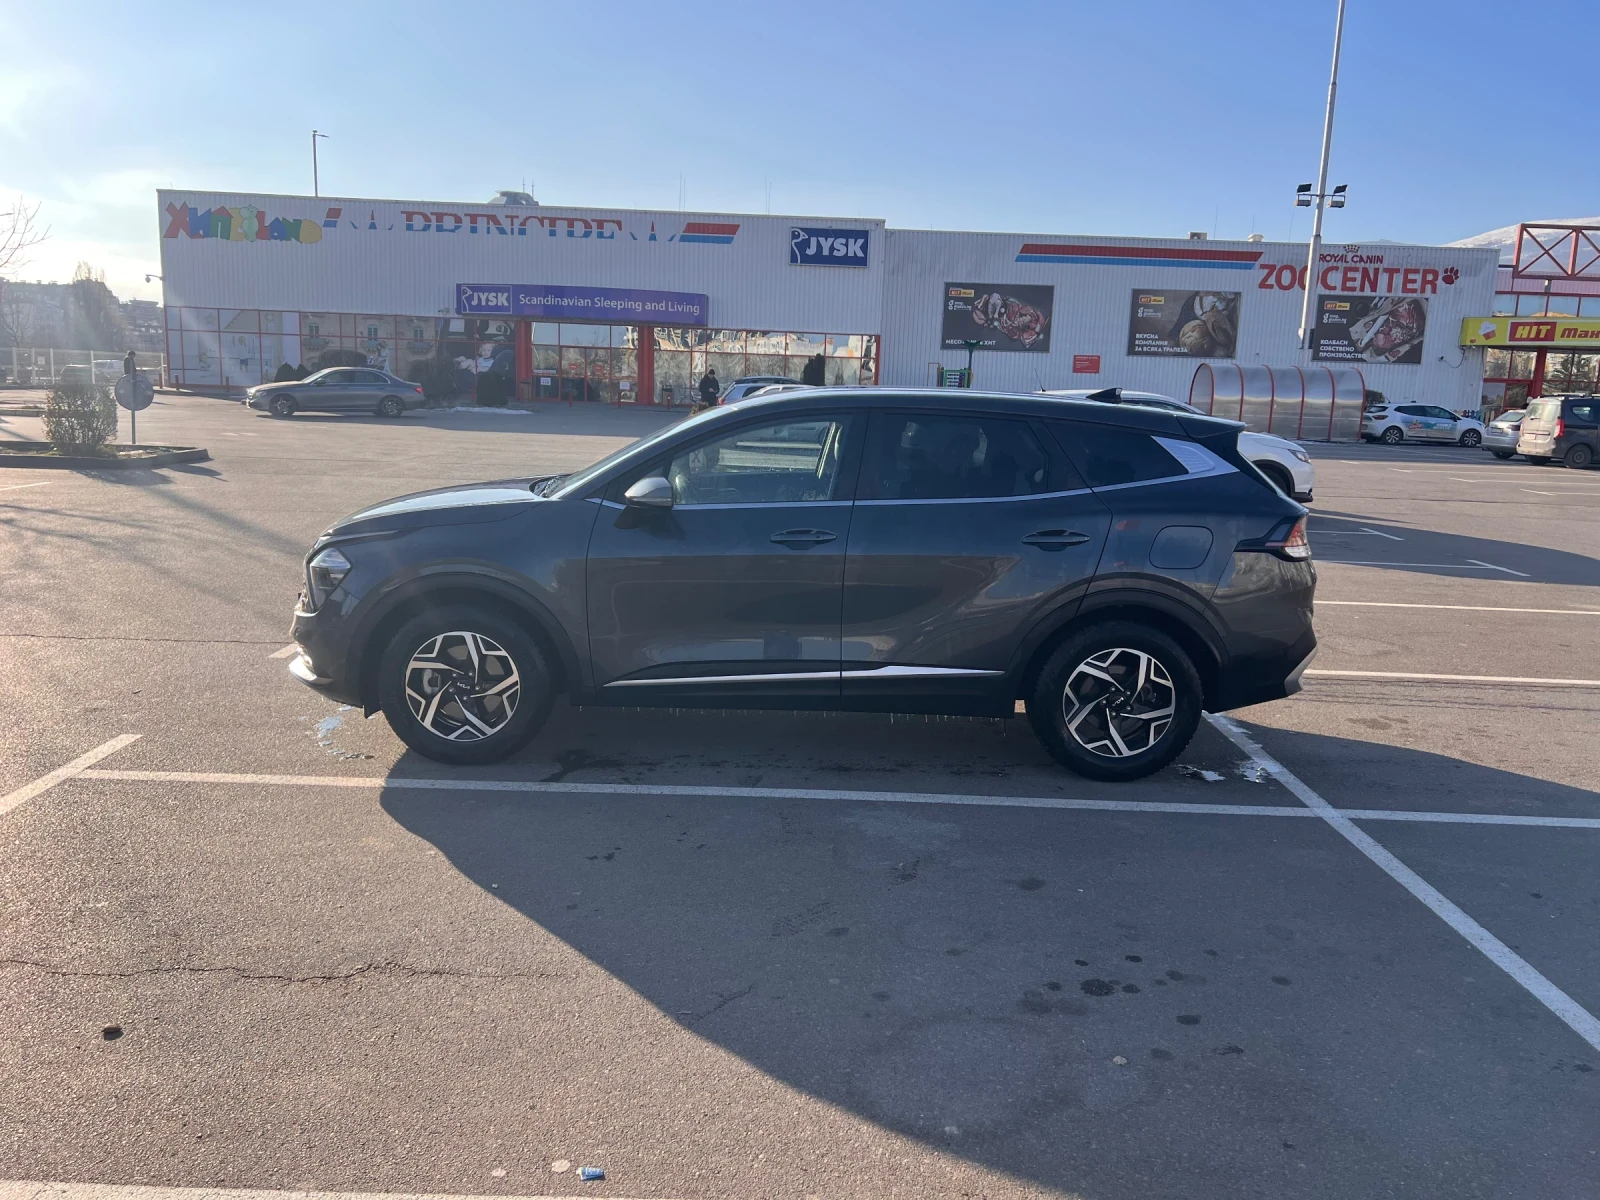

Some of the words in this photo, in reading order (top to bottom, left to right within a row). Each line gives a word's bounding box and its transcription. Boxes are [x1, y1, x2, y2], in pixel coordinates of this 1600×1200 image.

[805, 236, 865, 257] JYSK
[1319, 253, 1349, 263] ROYAL
[1351, 254, 1384, 264] CANIN
[471, 292, 509, 306] JYSK
[519, 294, 592, 307] Scandinavian
[594, 297, 643, 312] Sleeping
[645, 301, 666, 311] and
[668, 302, 700, 315] Living
[1515, 325, 1550, 338] HIT
[1560, 327, 1600, 338] Max
